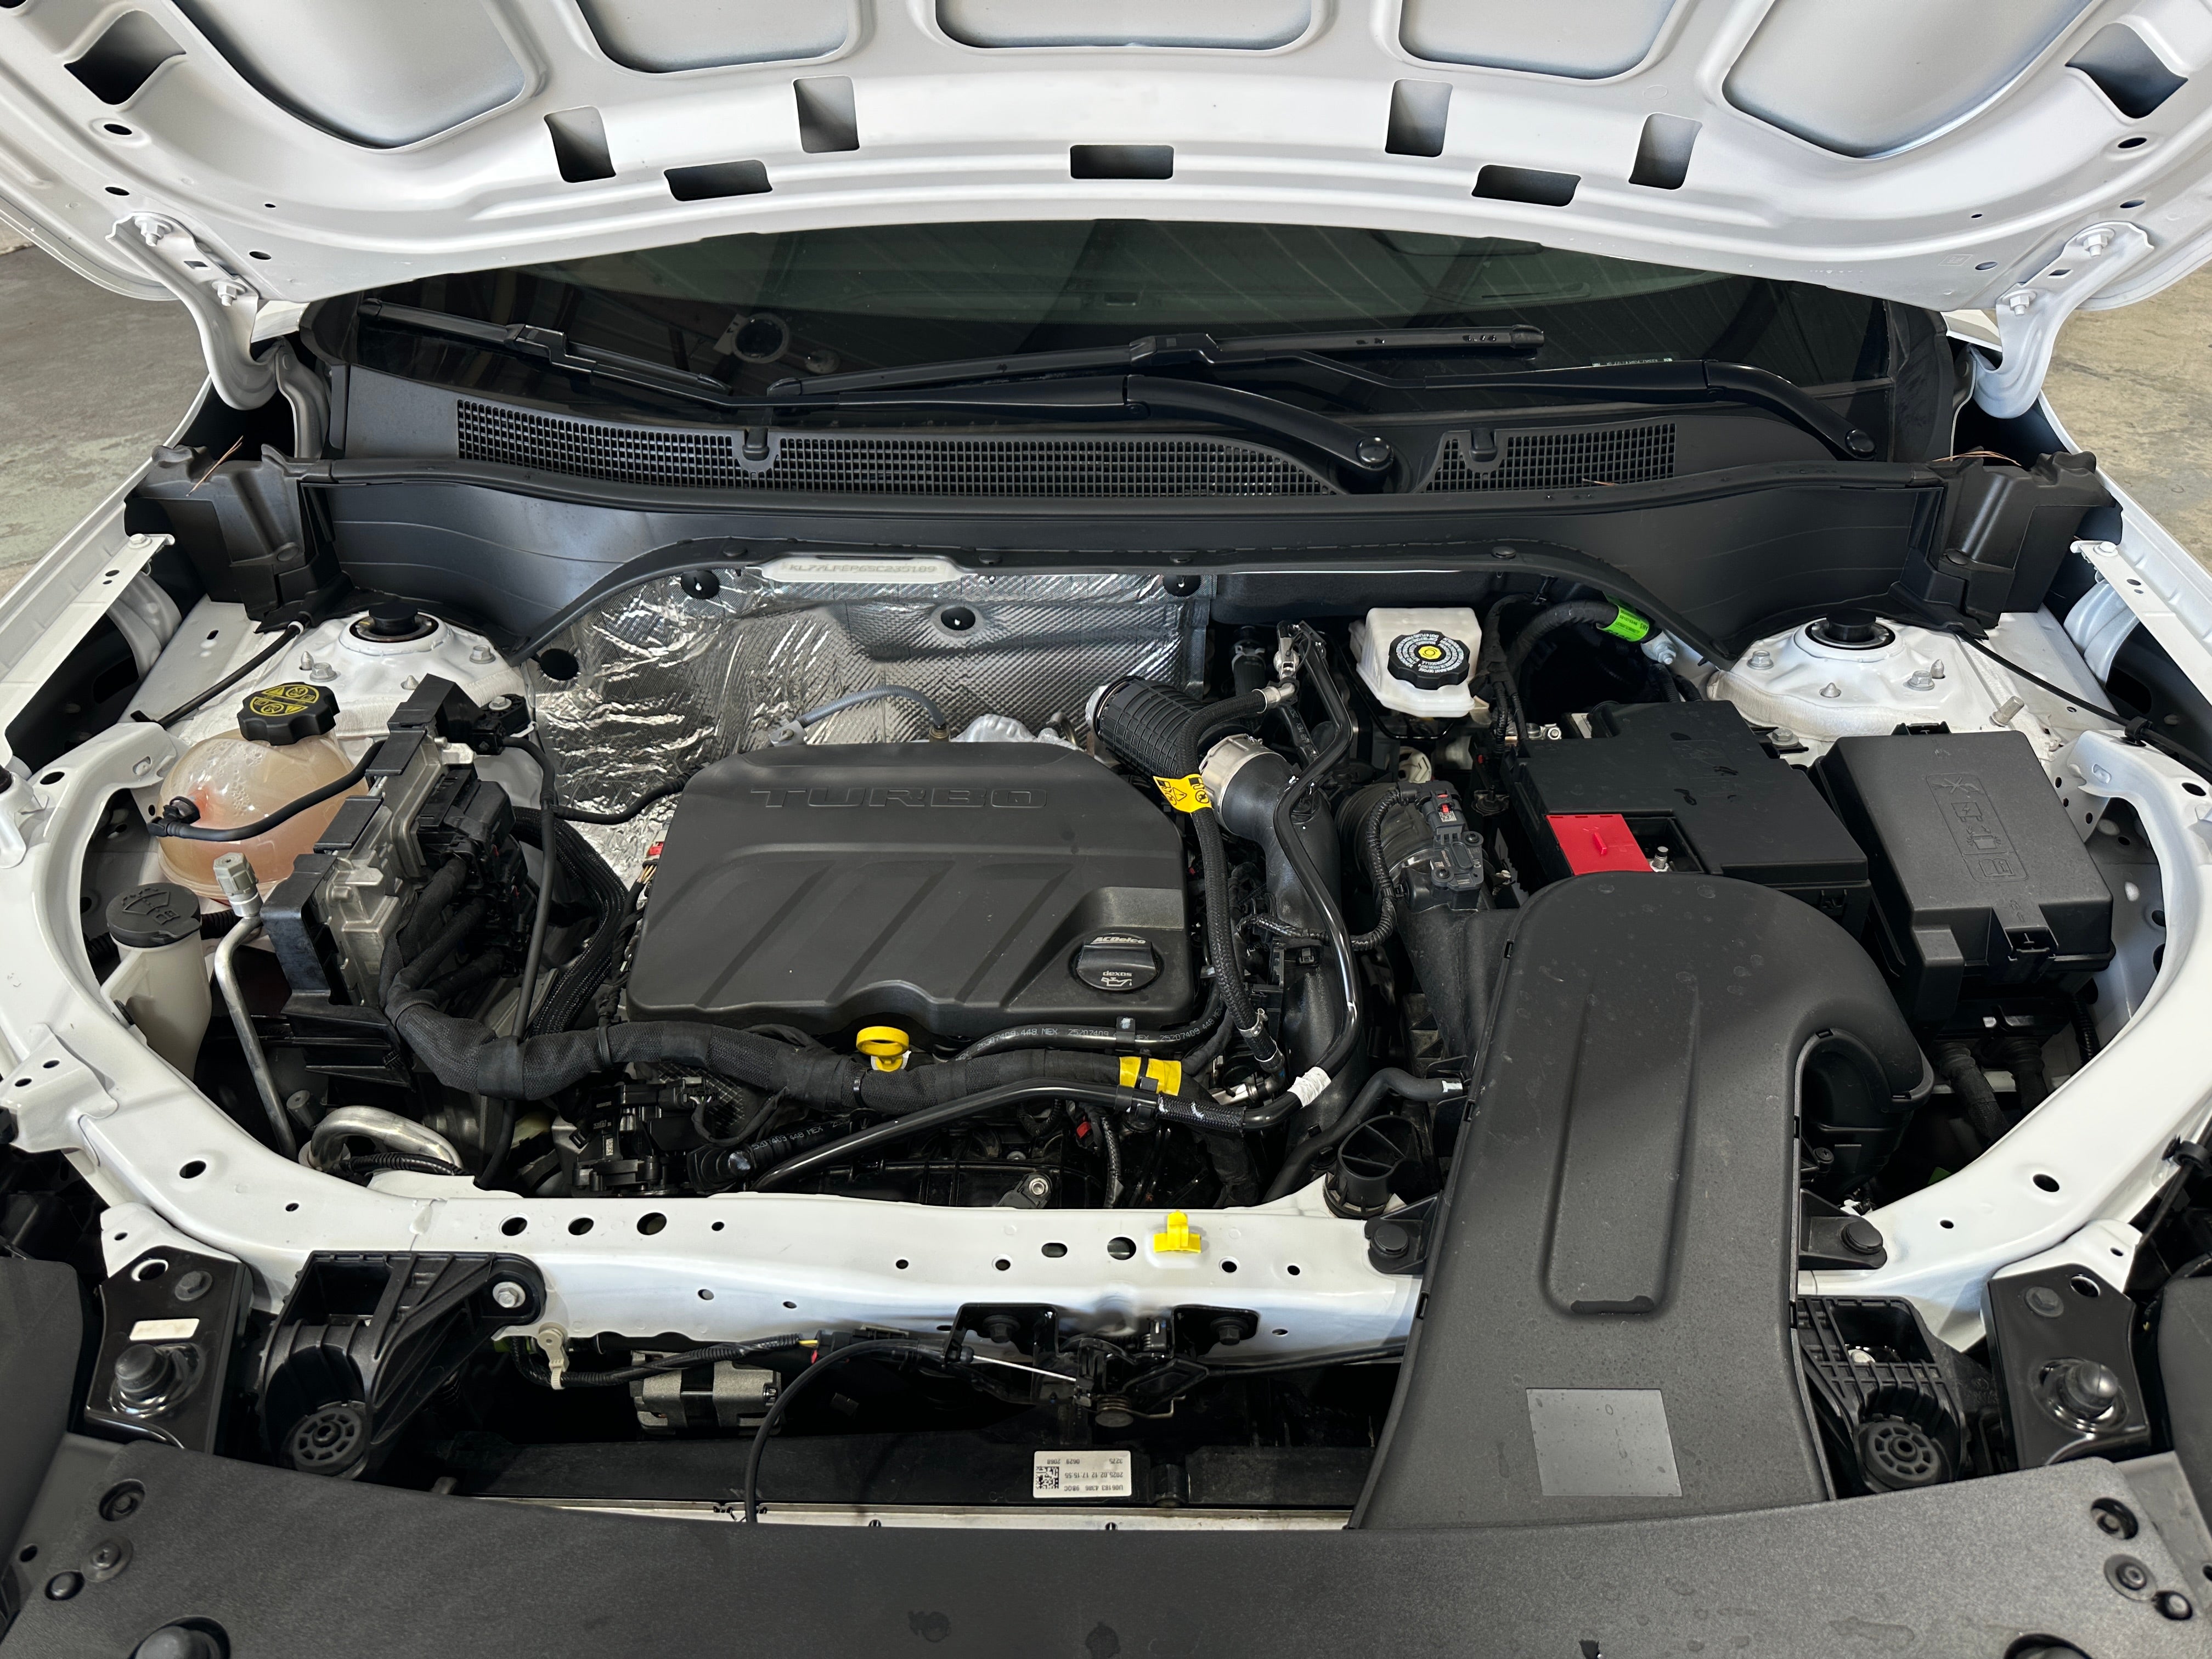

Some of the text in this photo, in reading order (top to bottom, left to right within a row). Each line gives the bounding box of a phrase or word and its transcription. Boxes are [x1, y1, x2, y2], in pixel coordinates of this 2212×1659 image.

[751, 788, 1048, 808] TURBO
[1041, 1028, 1059, 1036] MEX
[1159, 1027, 1201, 1041] 25207409
[806, 1125, 824, 1135] MEX
